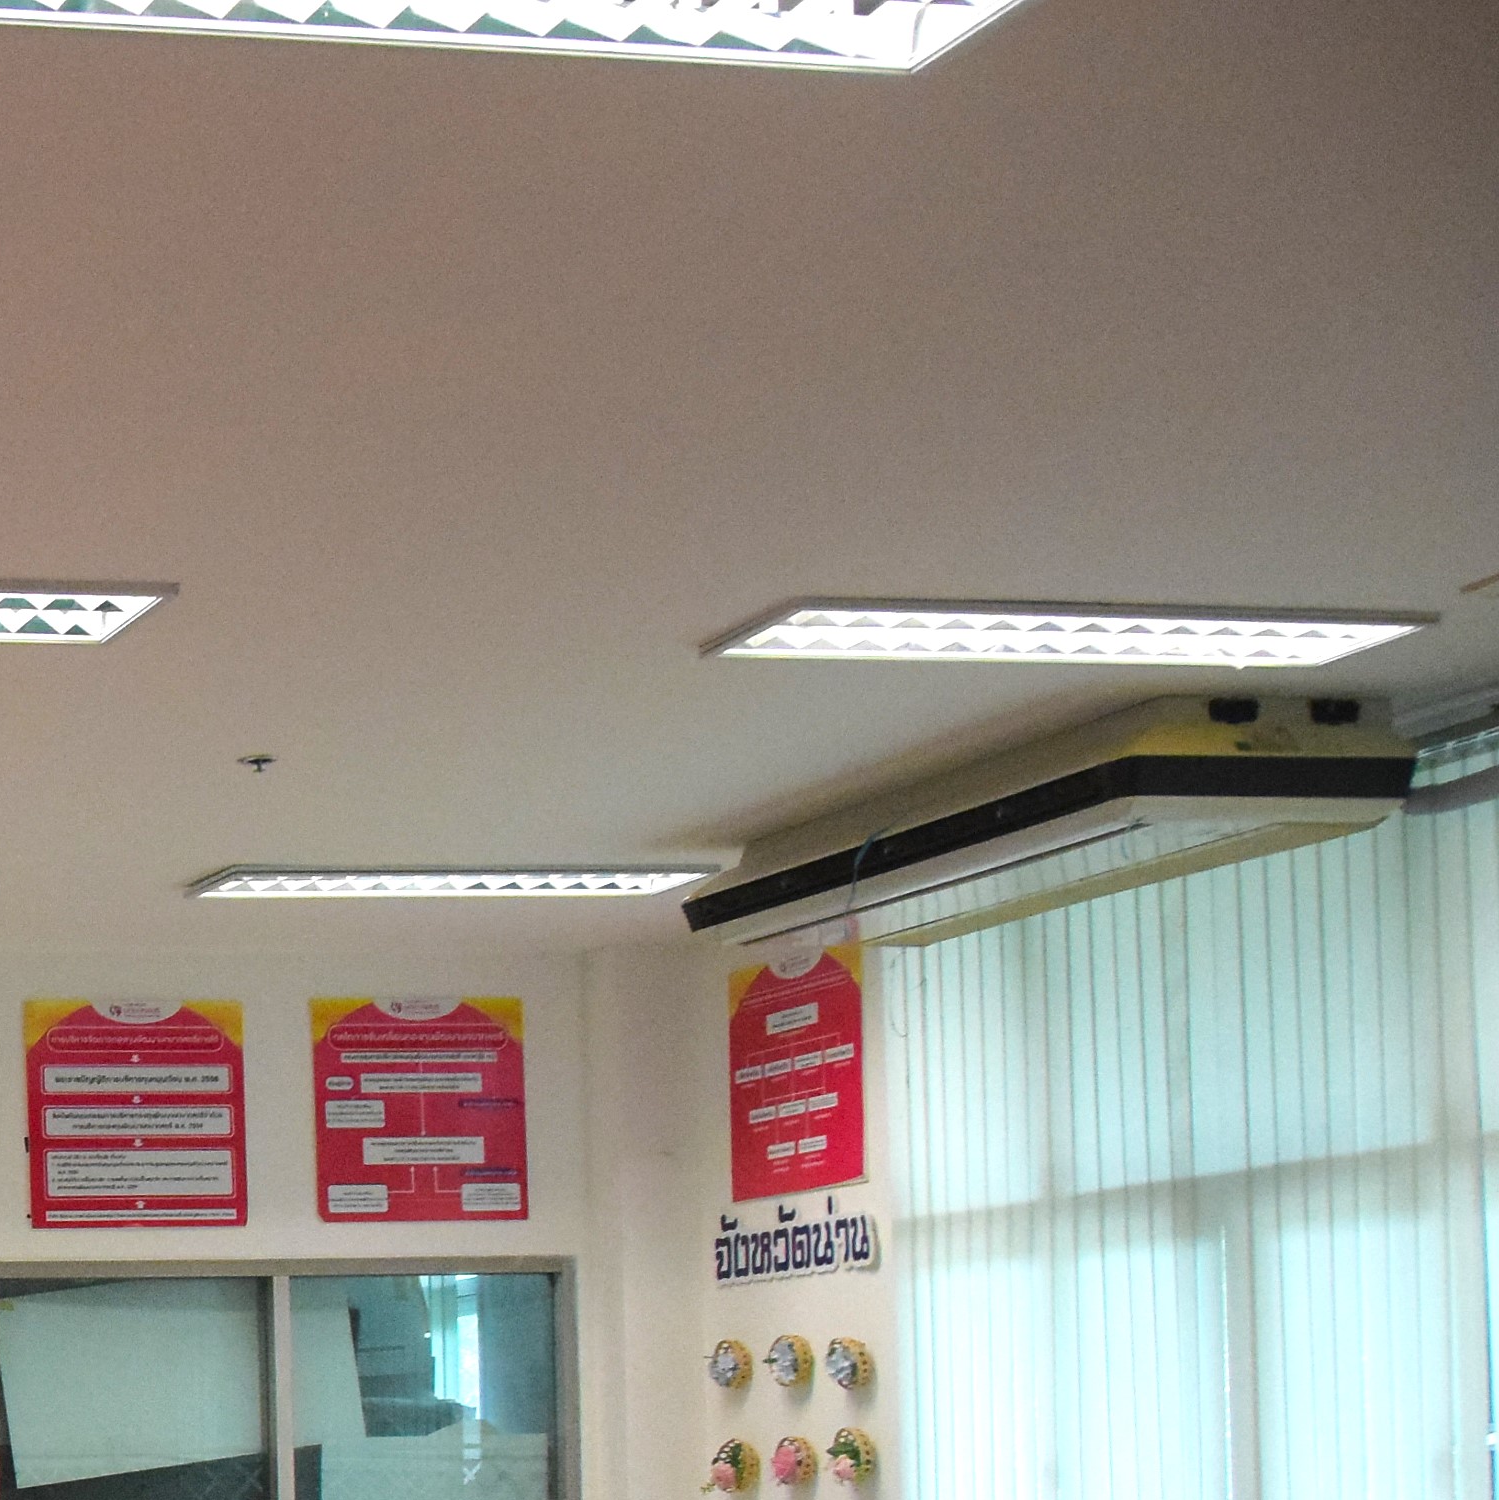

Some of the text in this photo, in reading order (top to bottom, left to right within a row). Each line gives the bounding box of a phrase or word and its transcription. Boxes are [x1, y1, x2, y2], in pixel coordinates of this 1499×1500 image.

[715, 1195, 870, 1280] จังหวัดน่าน
